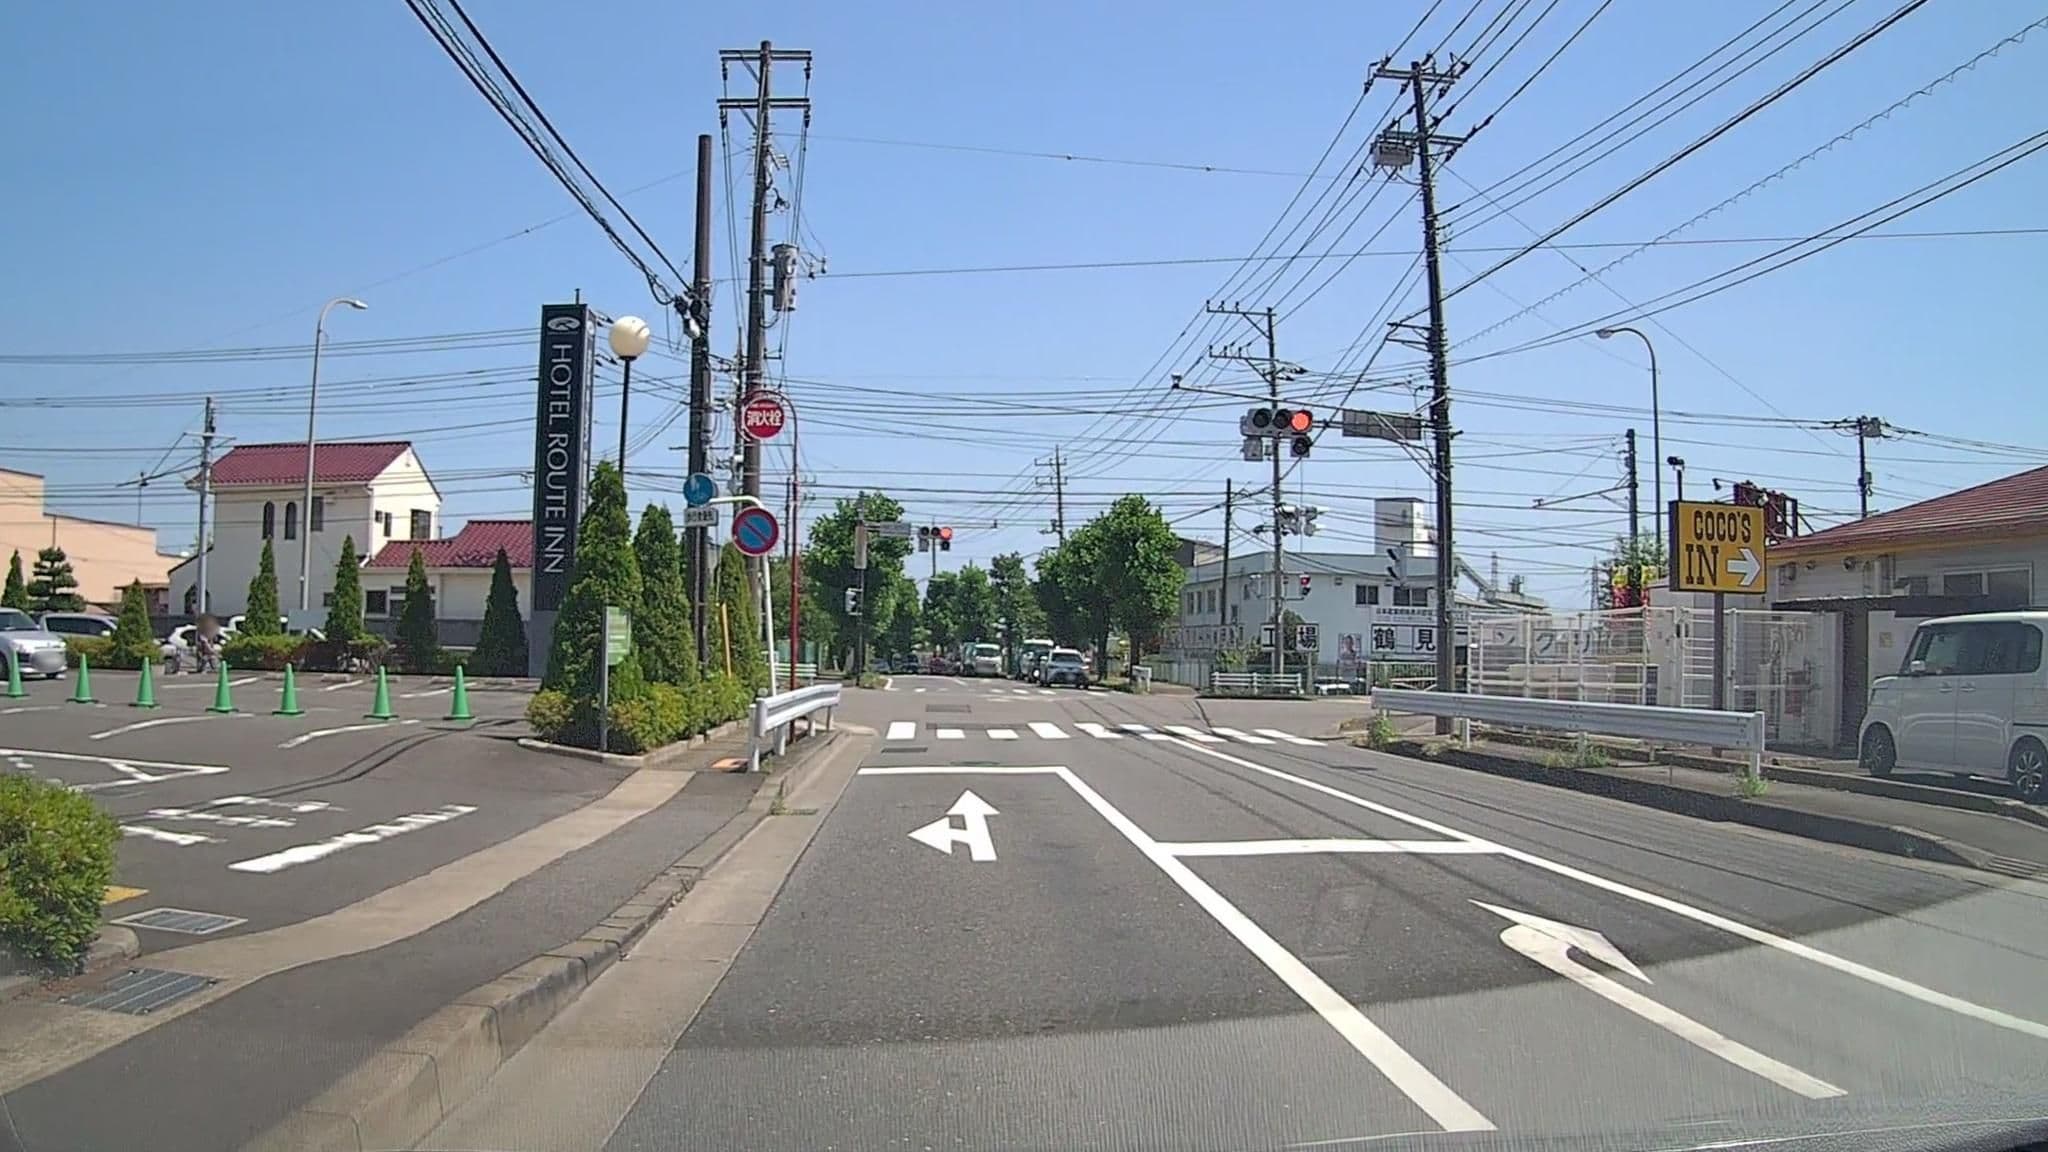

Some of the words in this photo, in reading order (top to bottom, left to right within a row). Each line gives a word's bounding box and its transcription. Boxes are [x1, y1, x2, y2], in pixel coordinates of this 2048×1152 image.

[549, 344, 573, 426] HOTEL
[746, 409, 782, 427] 消火栓
[546, 433, 569, 518] ROUTE
[1694, 510, 1751, 543] COCO'S
[543, 526, 568, 573] INN
[1685, 543, 1719, 586] IN
